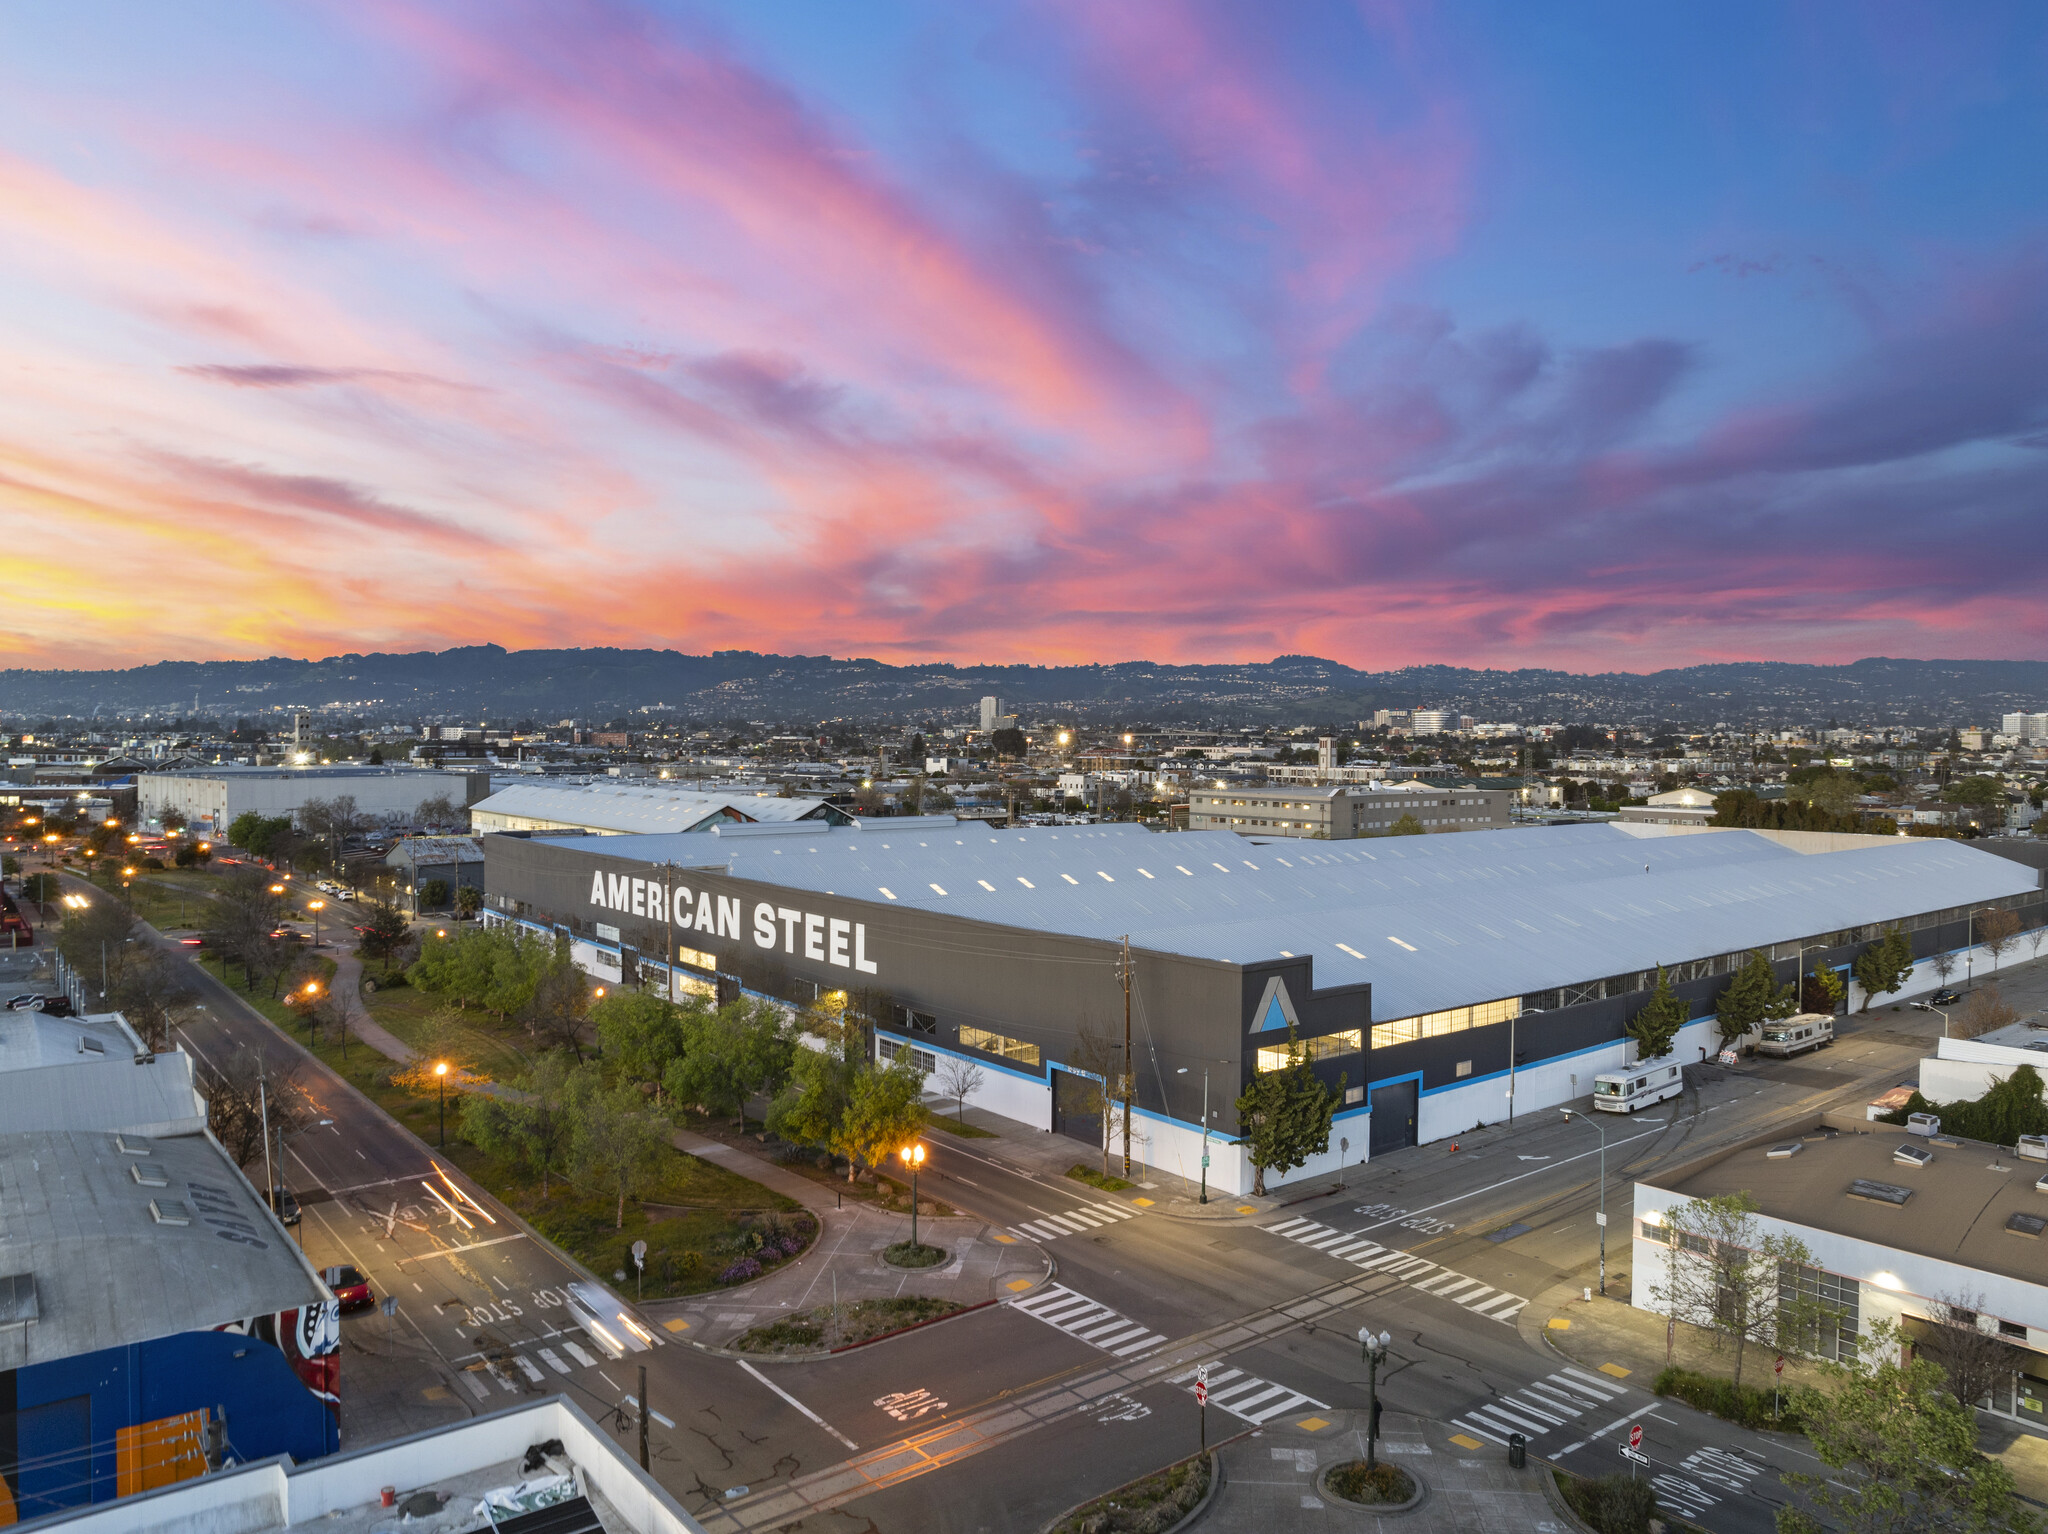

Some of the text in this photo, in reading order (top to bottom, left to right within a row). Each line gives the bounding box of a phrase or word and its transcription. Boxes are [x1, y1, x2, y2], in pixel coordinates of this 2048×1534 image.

[590, 870, 878, 975] AMERICAN STEEL
[1353, 1202, 1407, 1220] STOP
[1400, 1216, 1456, 1235] STOP
[465, 1299, 524, 1327] STOP
[1195, 1385, 1207, 1395] STOP
[872, 1388, 949, 1422] STOP
[1629, 1430, 1643, 1442] STOP
[1679, 1446, 1766, 1489] STOP
